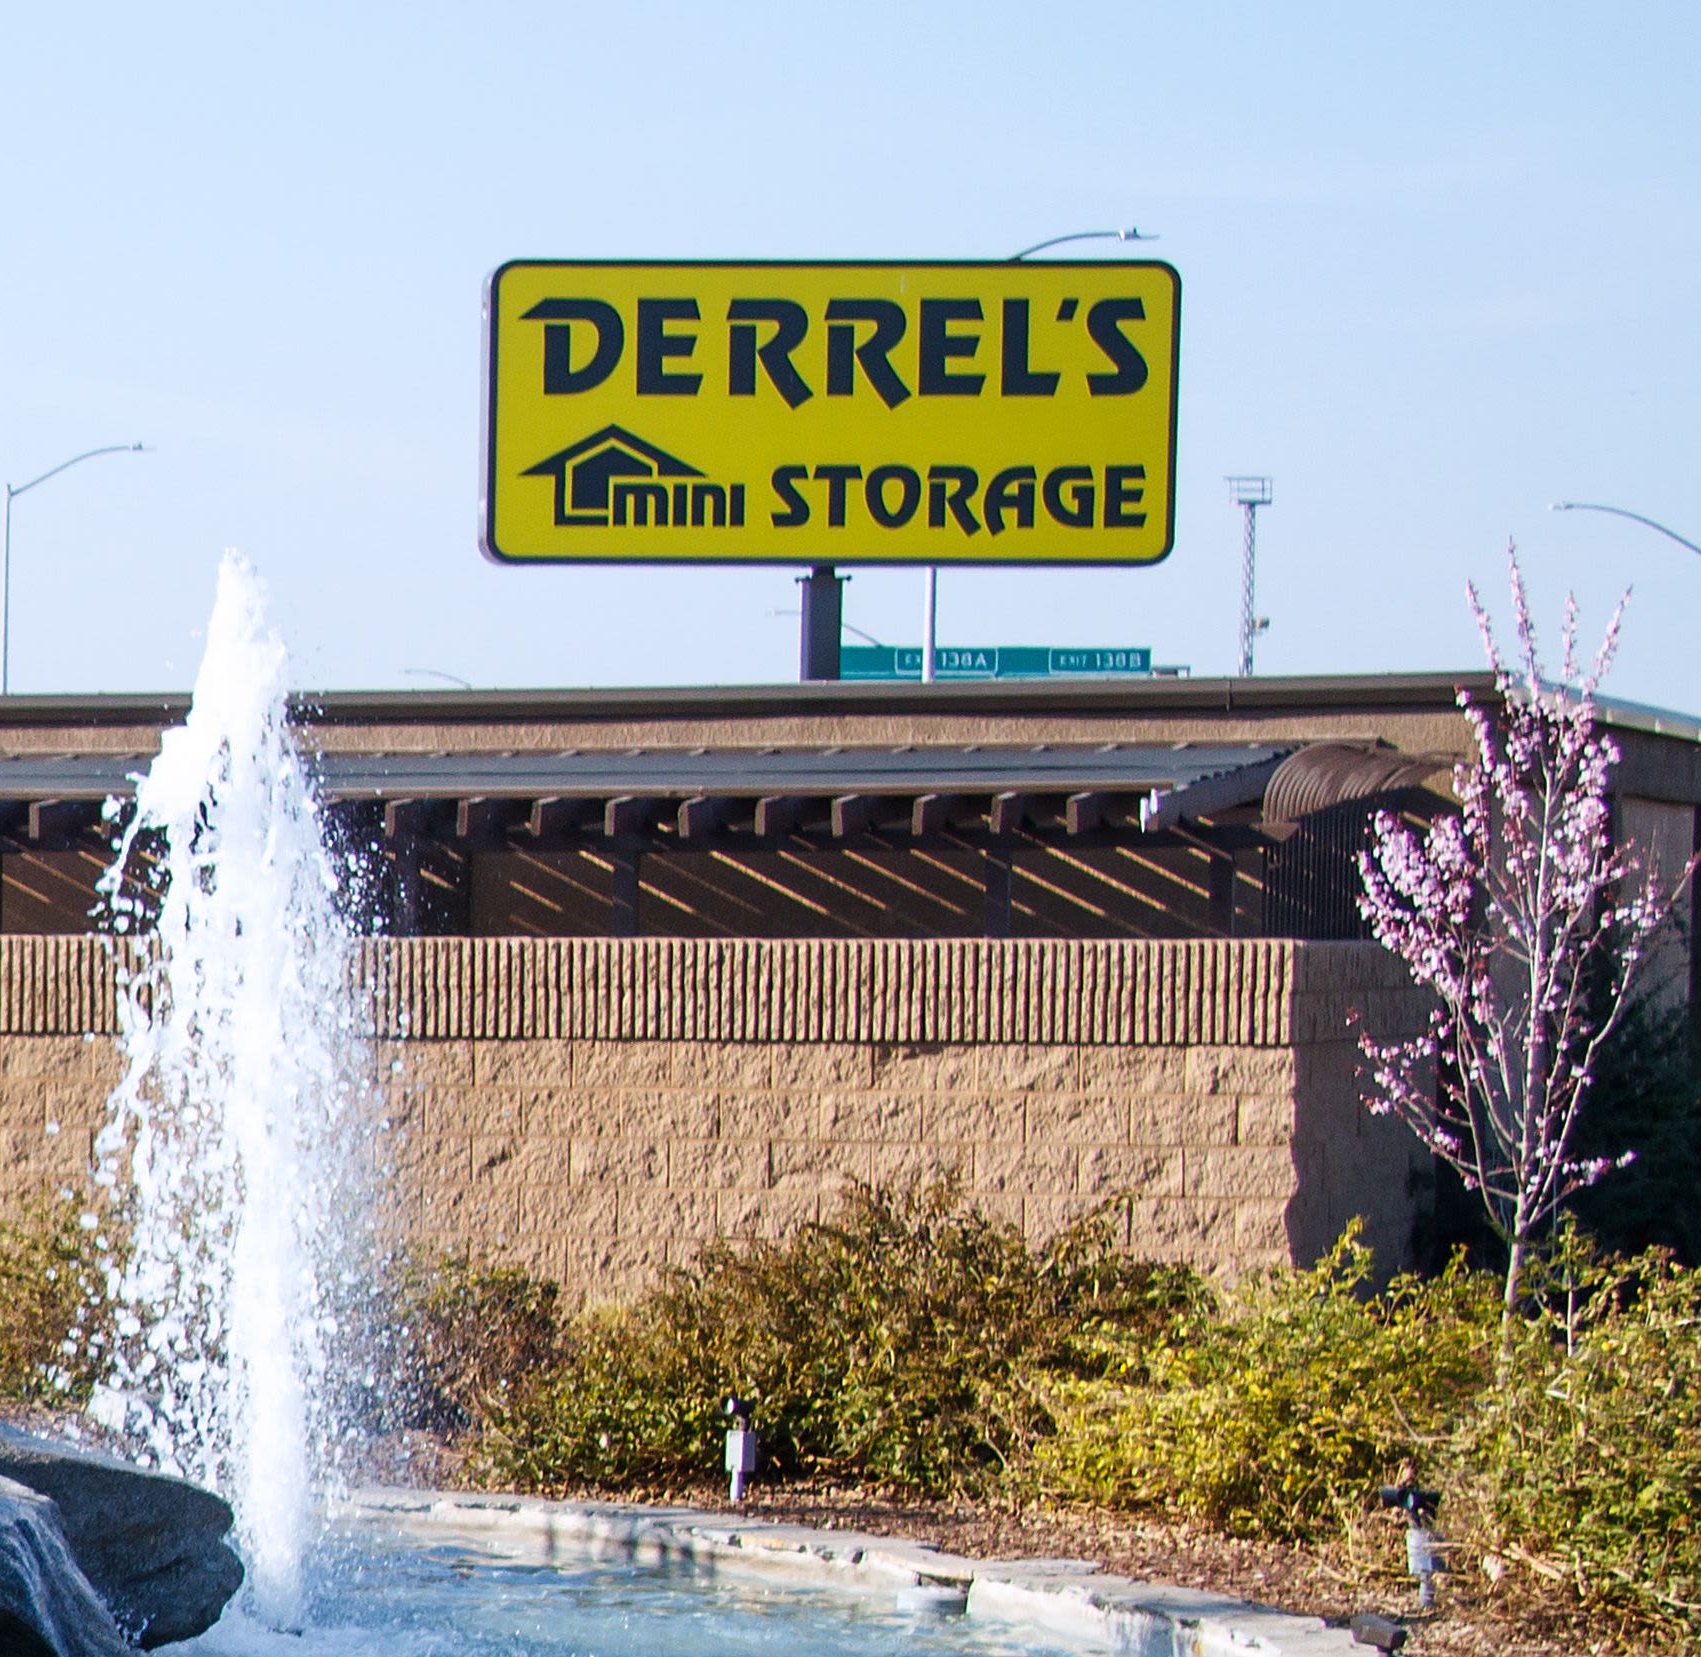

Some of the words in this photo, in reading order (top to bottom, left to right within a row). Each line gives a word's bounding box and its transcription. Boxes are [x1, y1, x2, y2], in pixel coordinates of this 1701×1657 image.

[518, 297, 1149, 410] DERREL'S
[771, 464, 1147, 537] STORAGE
[941, 652, 987, 669] 138A
